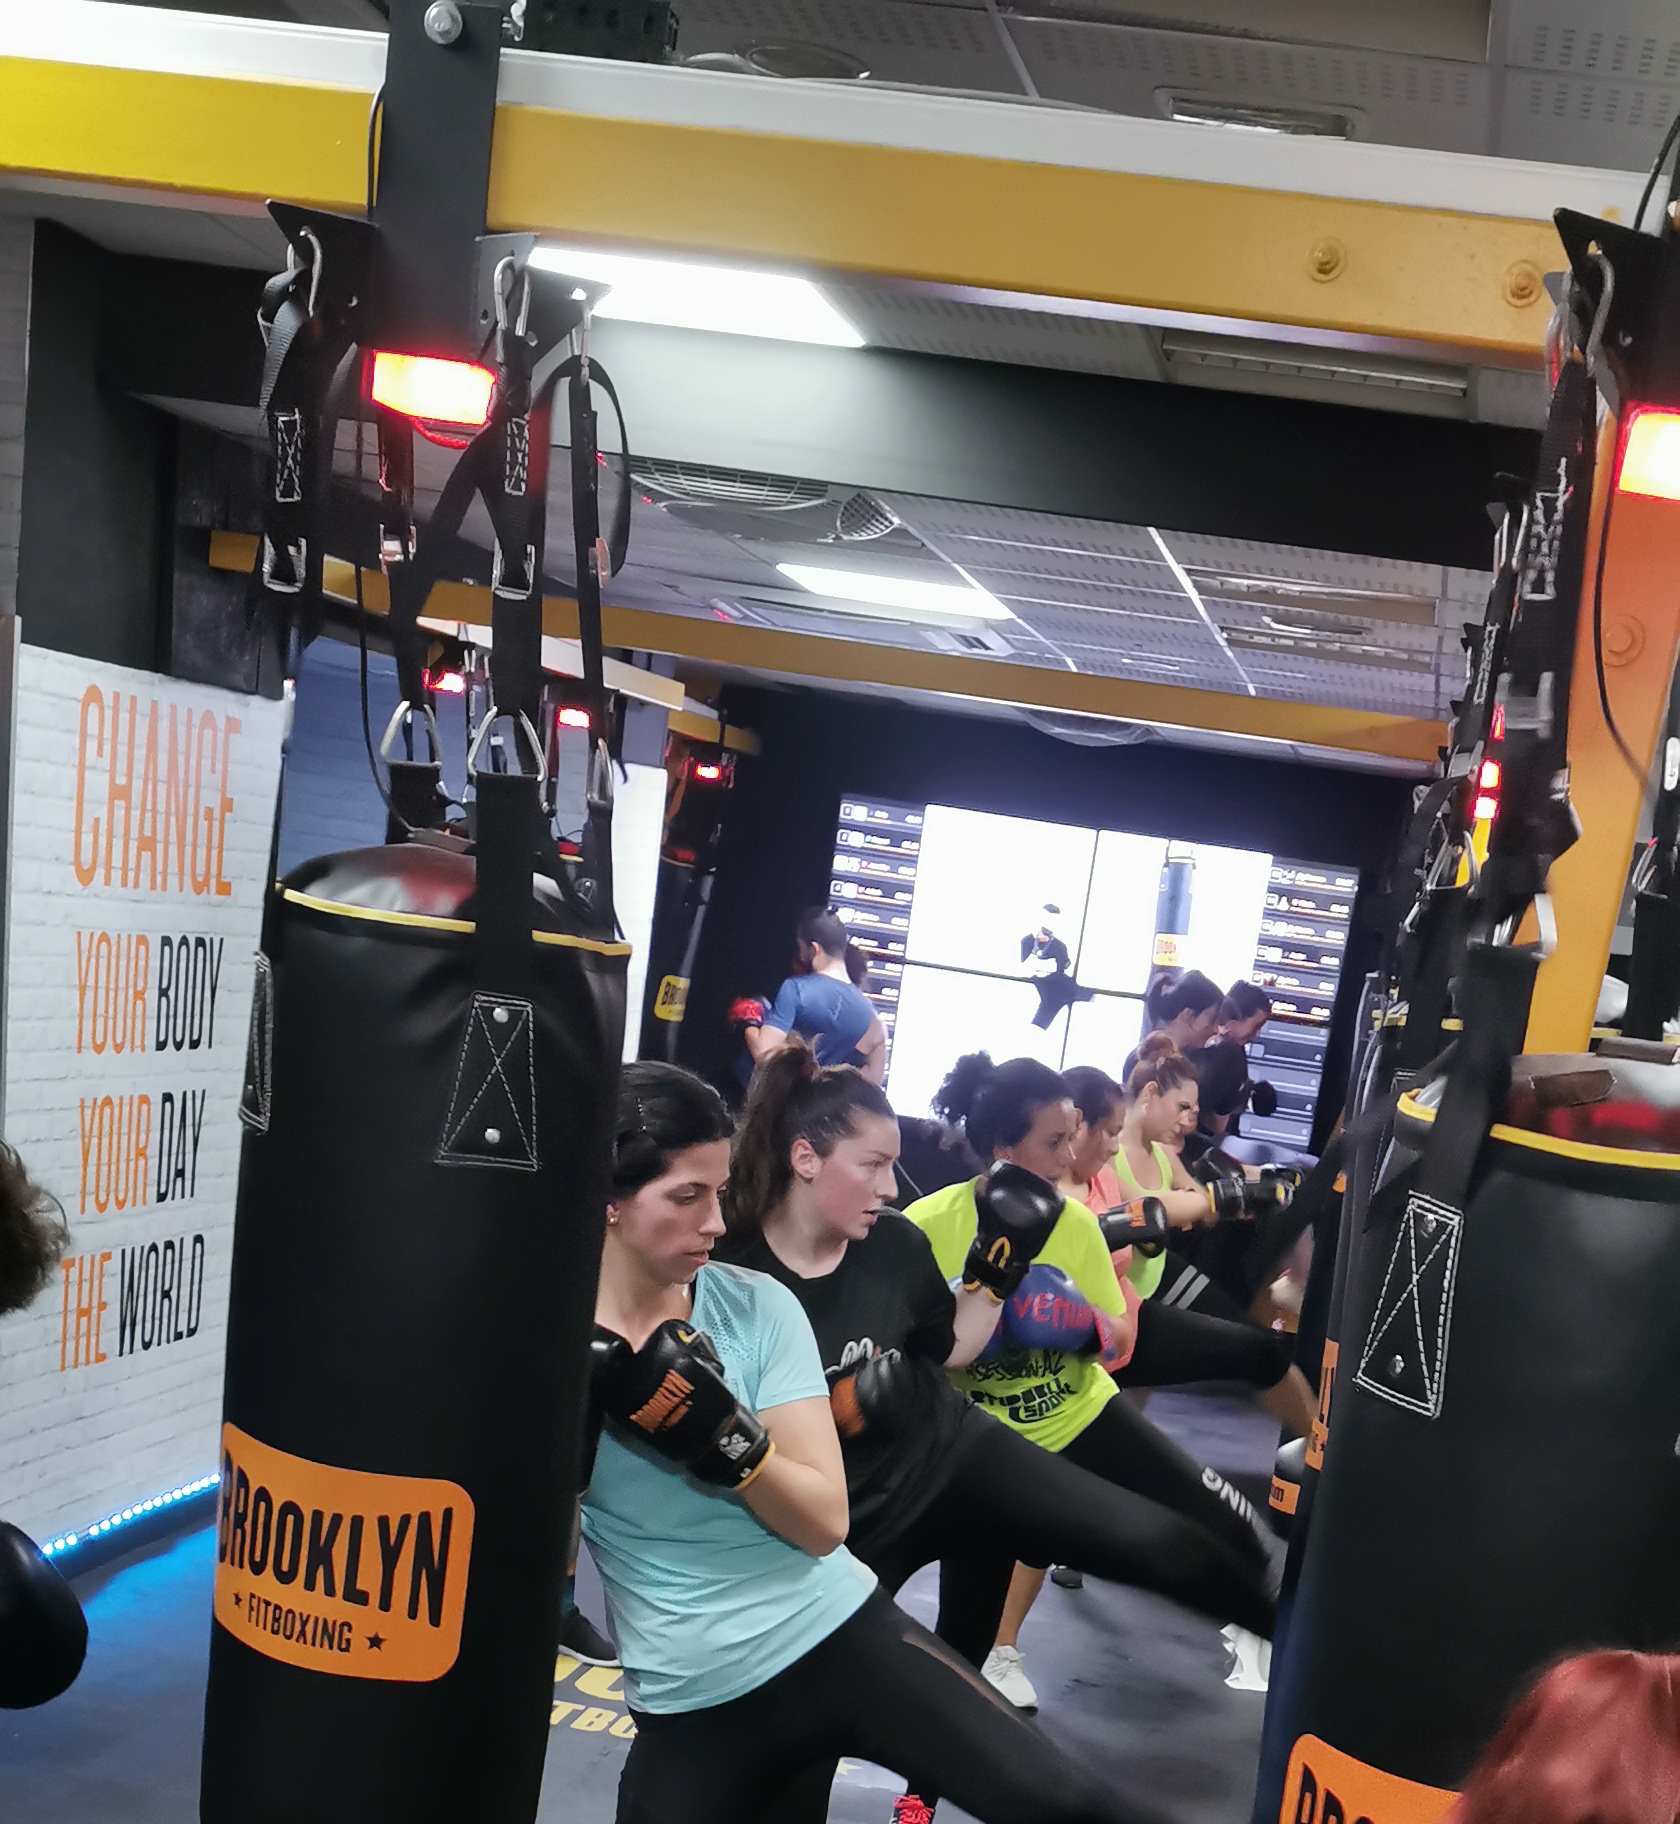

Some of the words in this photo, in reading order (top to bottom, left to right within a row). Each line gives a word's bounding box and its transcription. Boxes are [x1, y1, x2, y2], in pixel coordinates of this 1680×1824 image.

[73, 684, 242, 897] CHANGE
[75, 930, 151, 1056] YOUR
[154, 936, 224, 1054] BODY
[78, 1093, 151, 1216] YOUR
[155, 1090, 207, 1204] DAY
[60, 1250, 112, 1373] THE
[118, 1233, 206, 1358] WORLD
[219, 1448, 454, 1629] BROOKLYN
[247, 1592, 353, 1653] FITBOXING
